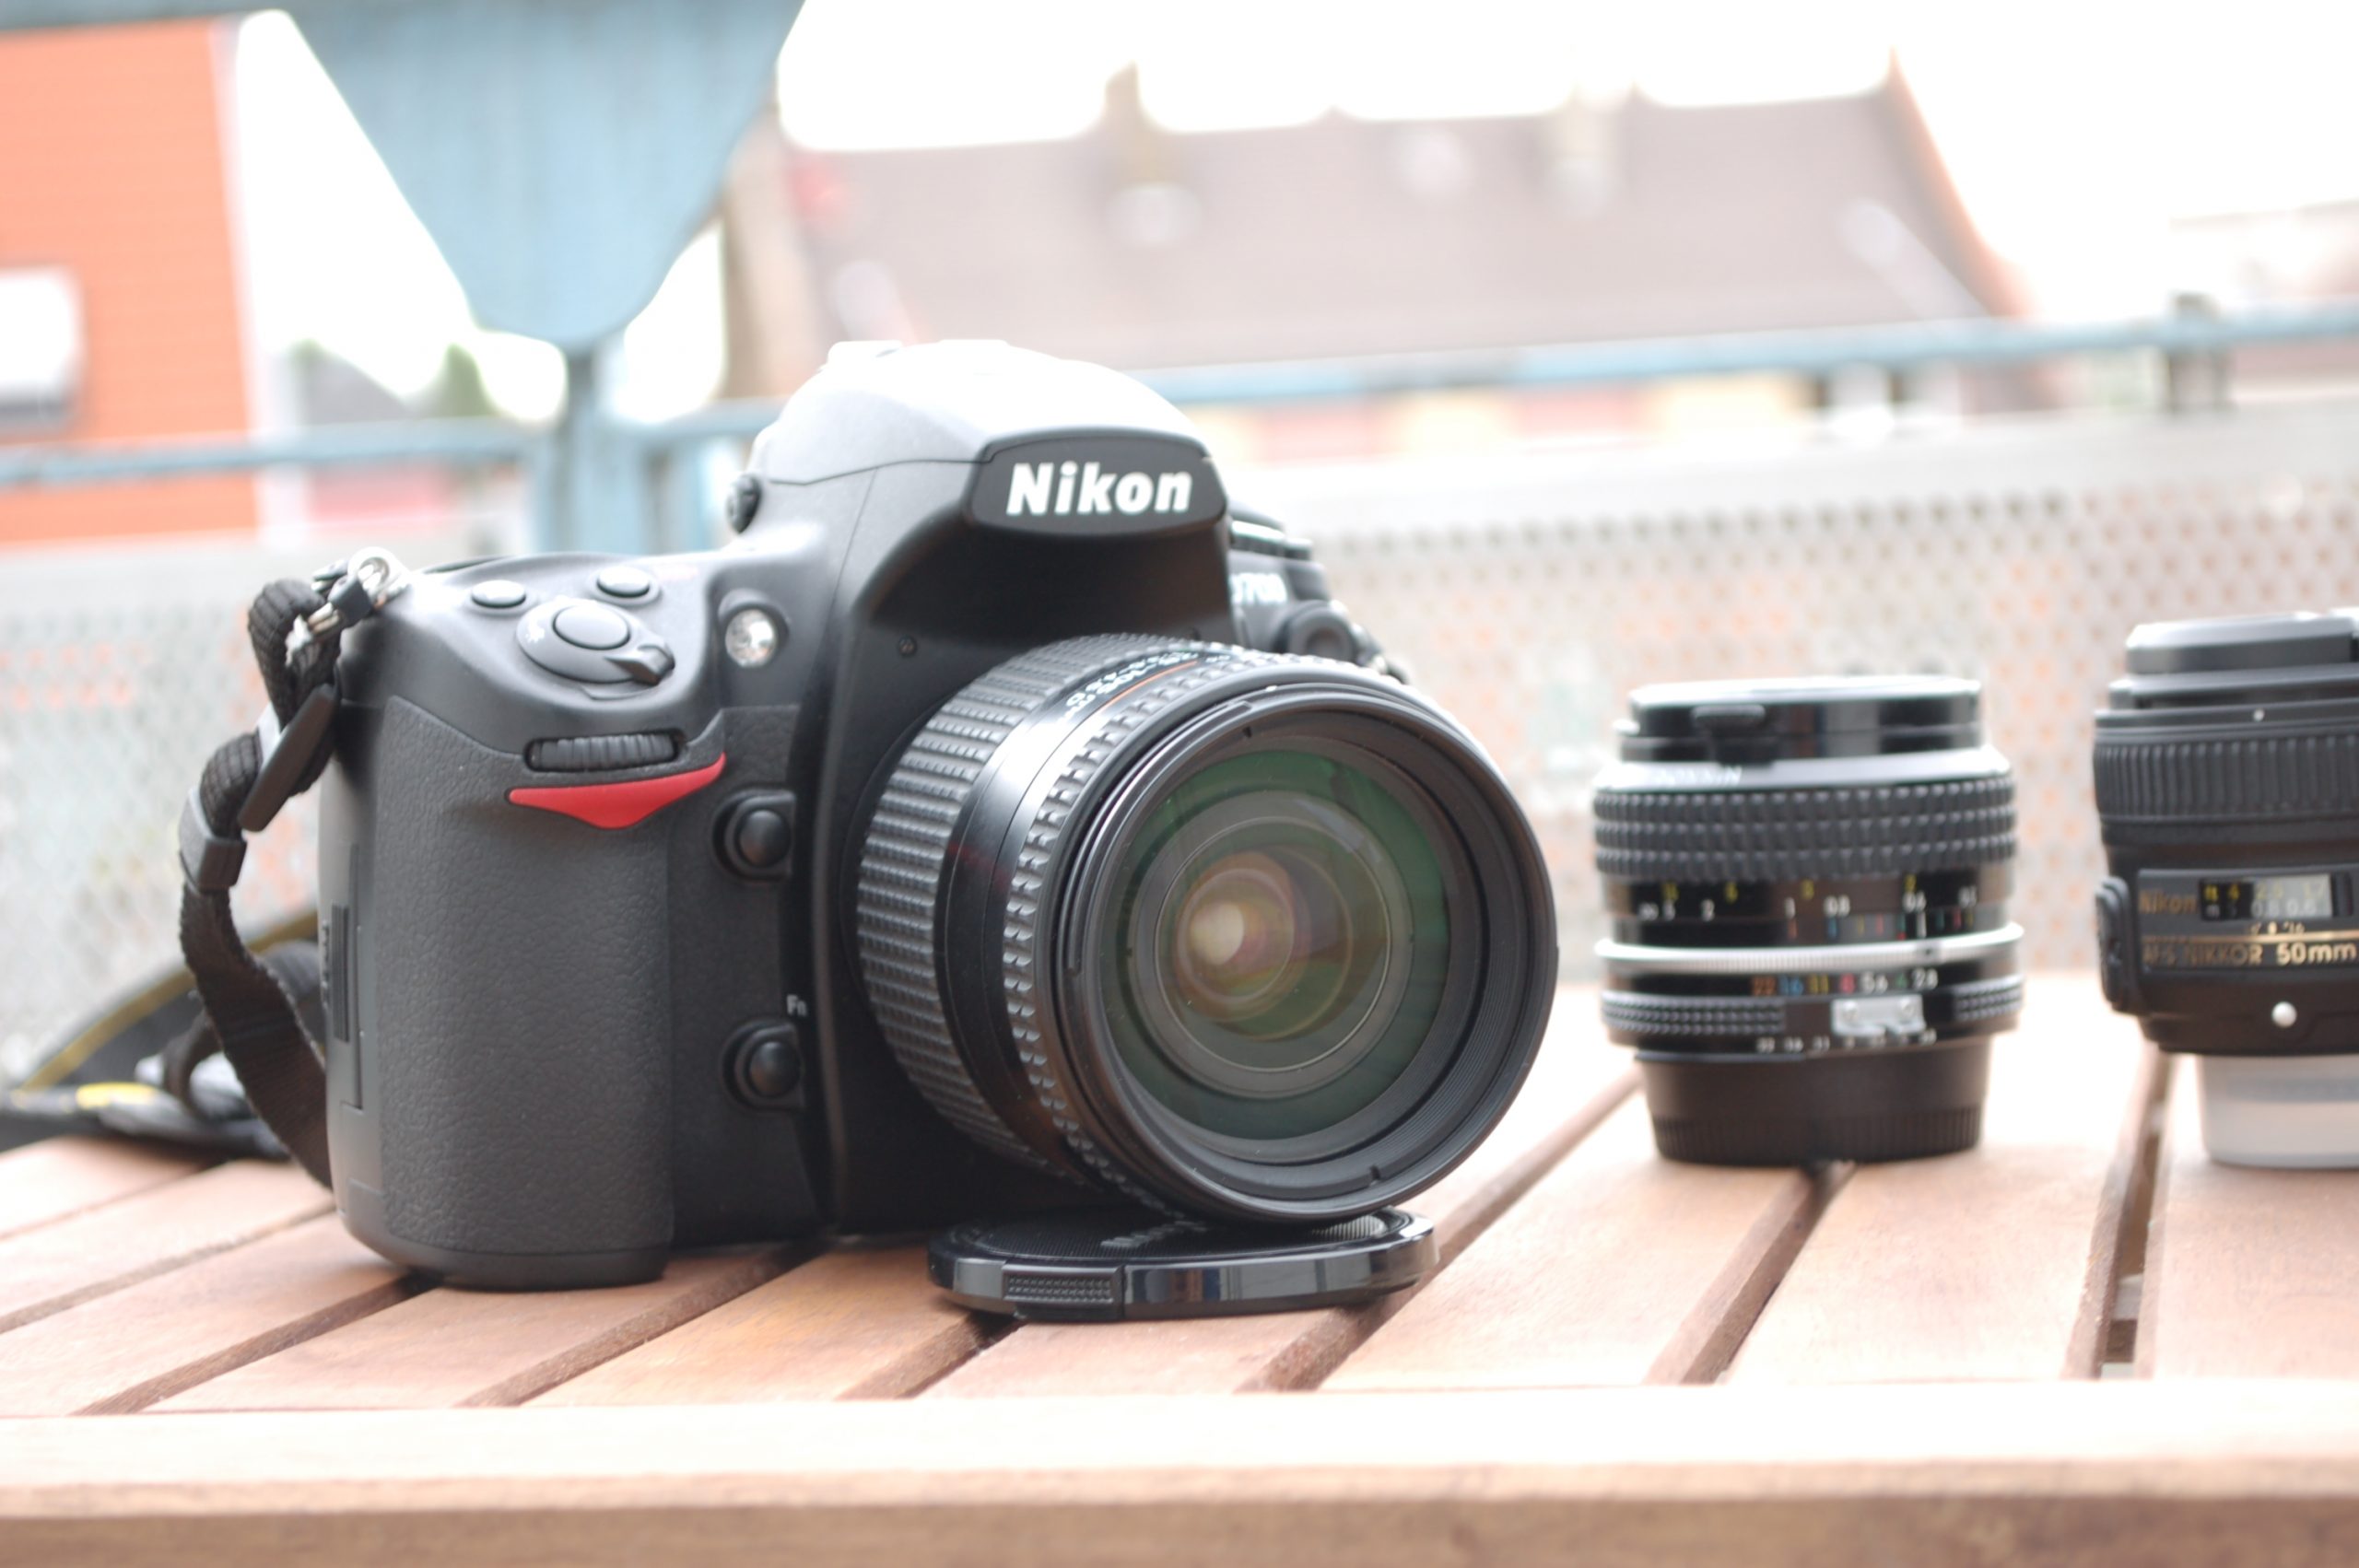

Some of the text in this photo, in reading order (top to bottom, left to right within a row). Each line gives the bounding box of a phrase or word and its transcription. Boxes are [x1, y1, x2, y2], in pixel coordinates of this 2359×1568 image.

[1006, 461, 1193, 516] Nikon
[2277, 940, 2357, 967] 50mm
[786, 993, 808, 1017] Fn
